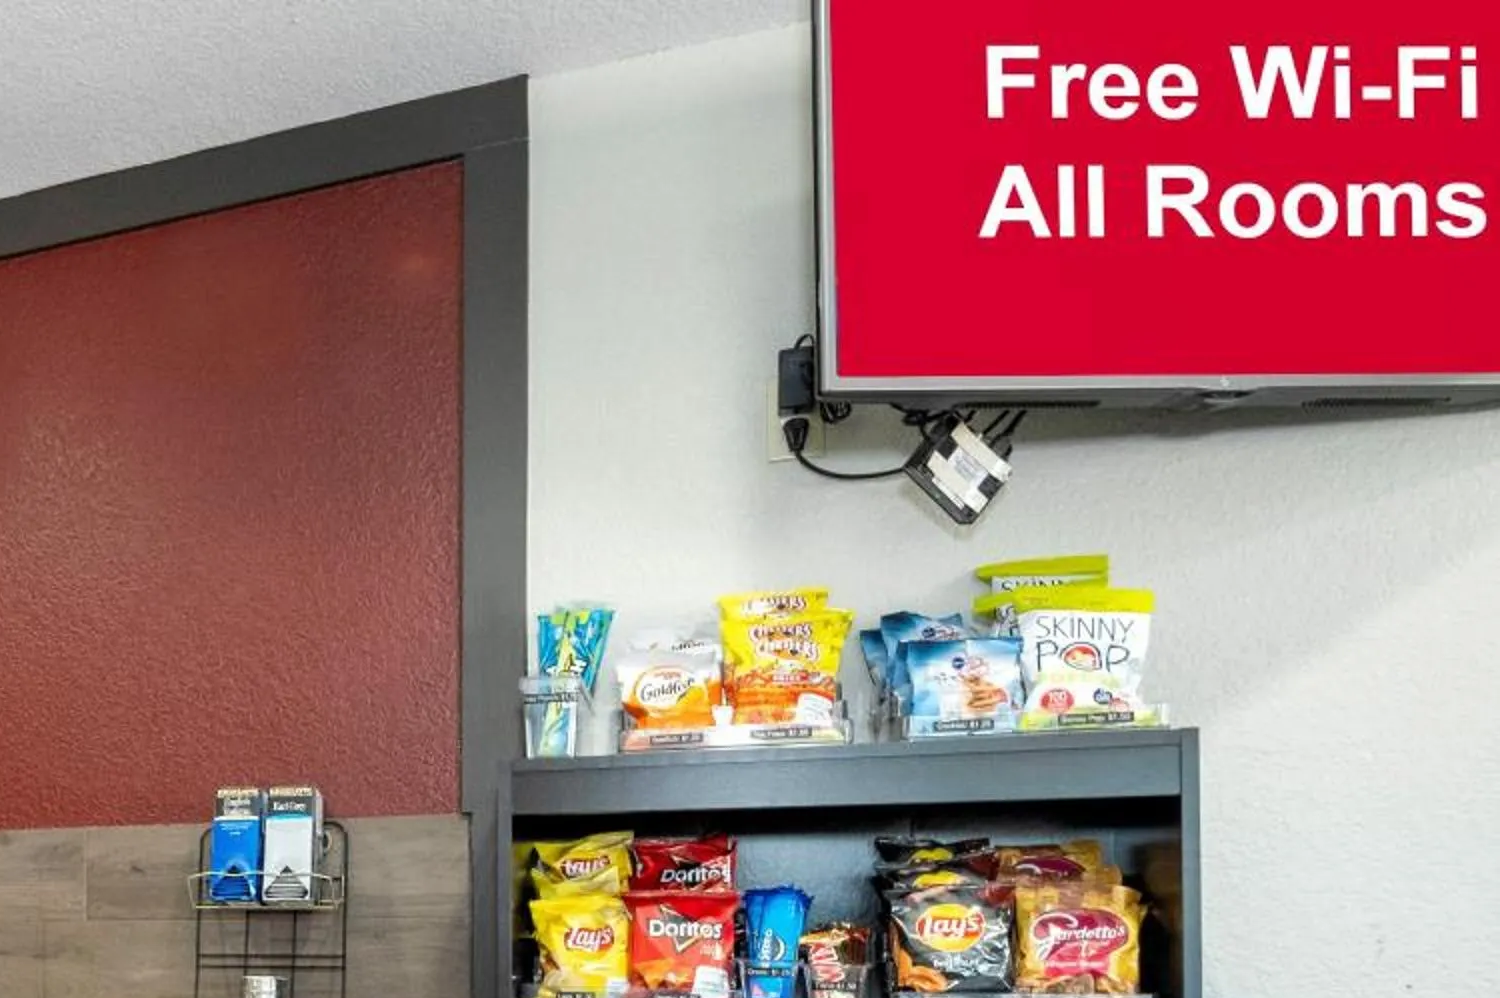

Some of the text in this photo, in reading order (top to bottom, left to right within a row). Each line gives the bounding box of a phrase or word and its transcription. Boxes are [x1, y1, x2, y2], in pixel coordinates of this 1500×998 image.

[985, 45, 1479, 121] Free Wi-Fi
[978, 164, 1488, 239] All Rooms
[1036, 615, 1134, 643] SKINNY
[1036, 640, 1130, 672] POP
[661, 867, 731, 883] Doritos
[649, 919, 722, 938] Doritos
